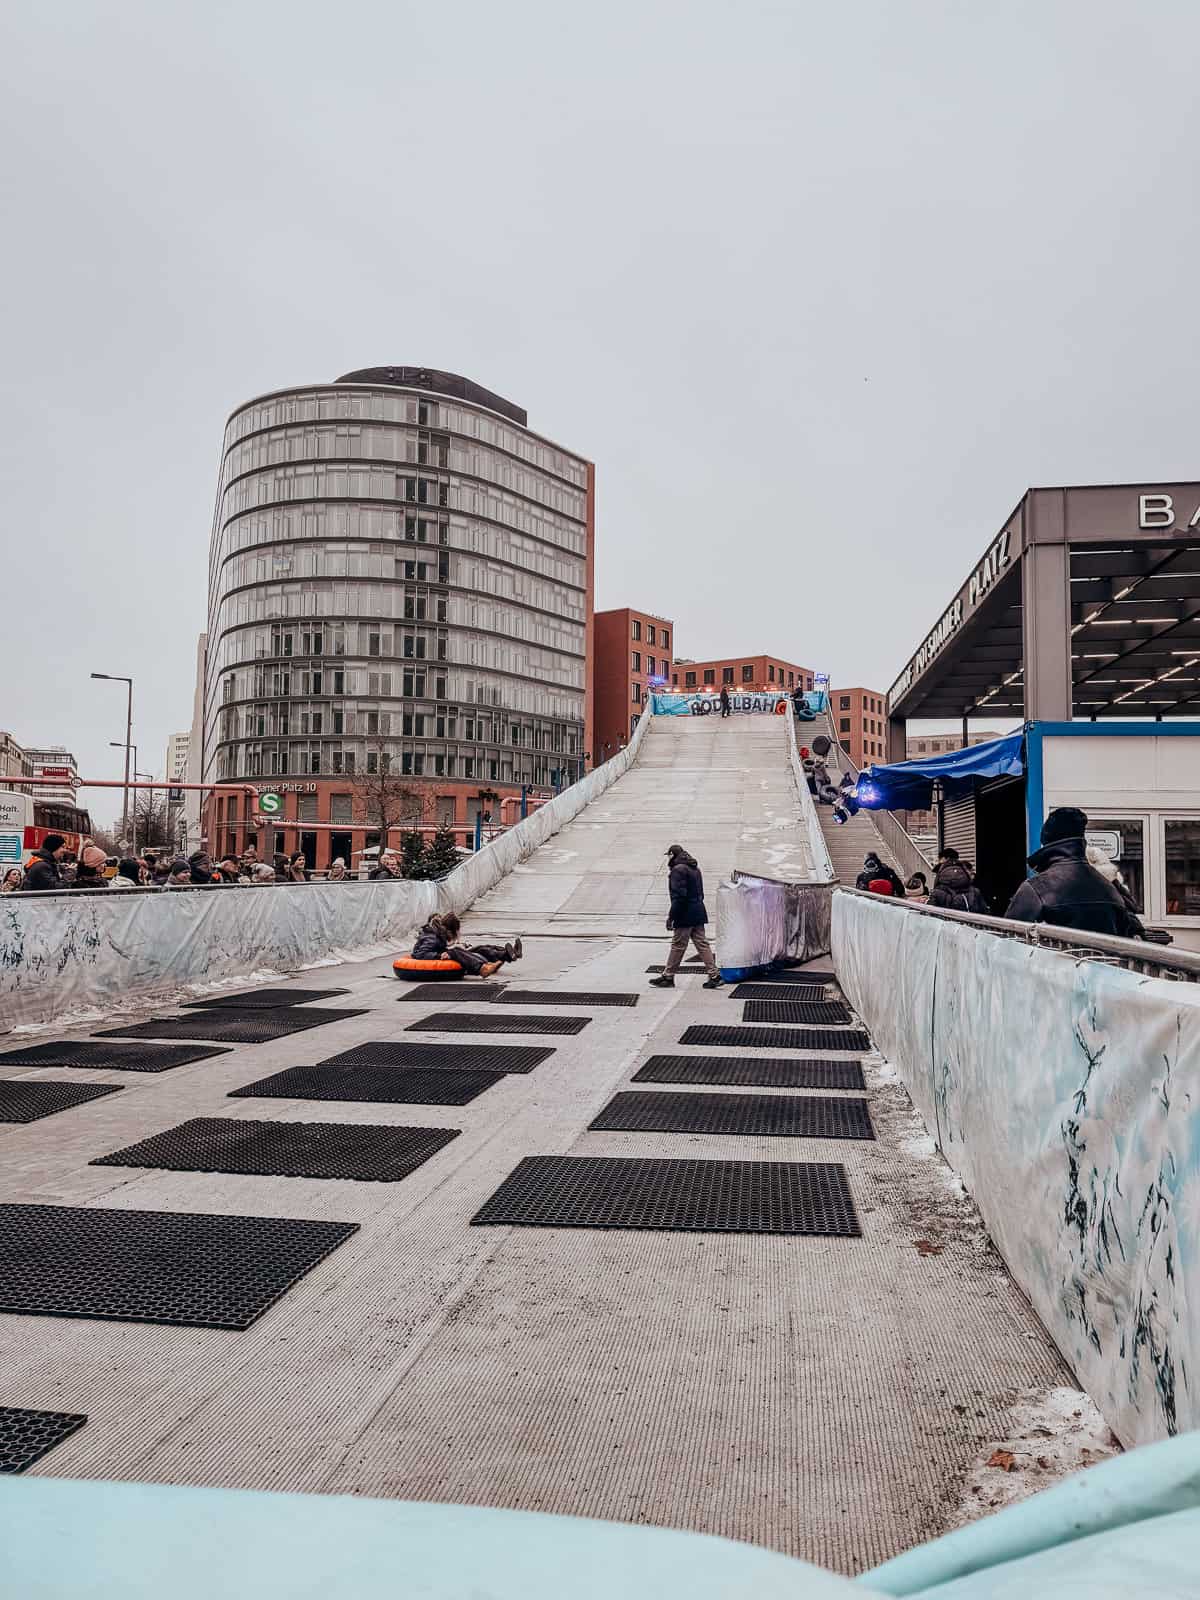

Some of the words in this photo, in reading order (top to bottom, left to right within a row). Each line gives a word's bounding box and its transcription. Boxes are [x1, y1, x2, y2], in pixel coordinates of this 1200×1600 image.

[969, 531, 1010, 606] PLATZ
[282, 783, 303, 792] Platz
[306, 782, 317, 792] 10
[262, 793, 279, 812] S
